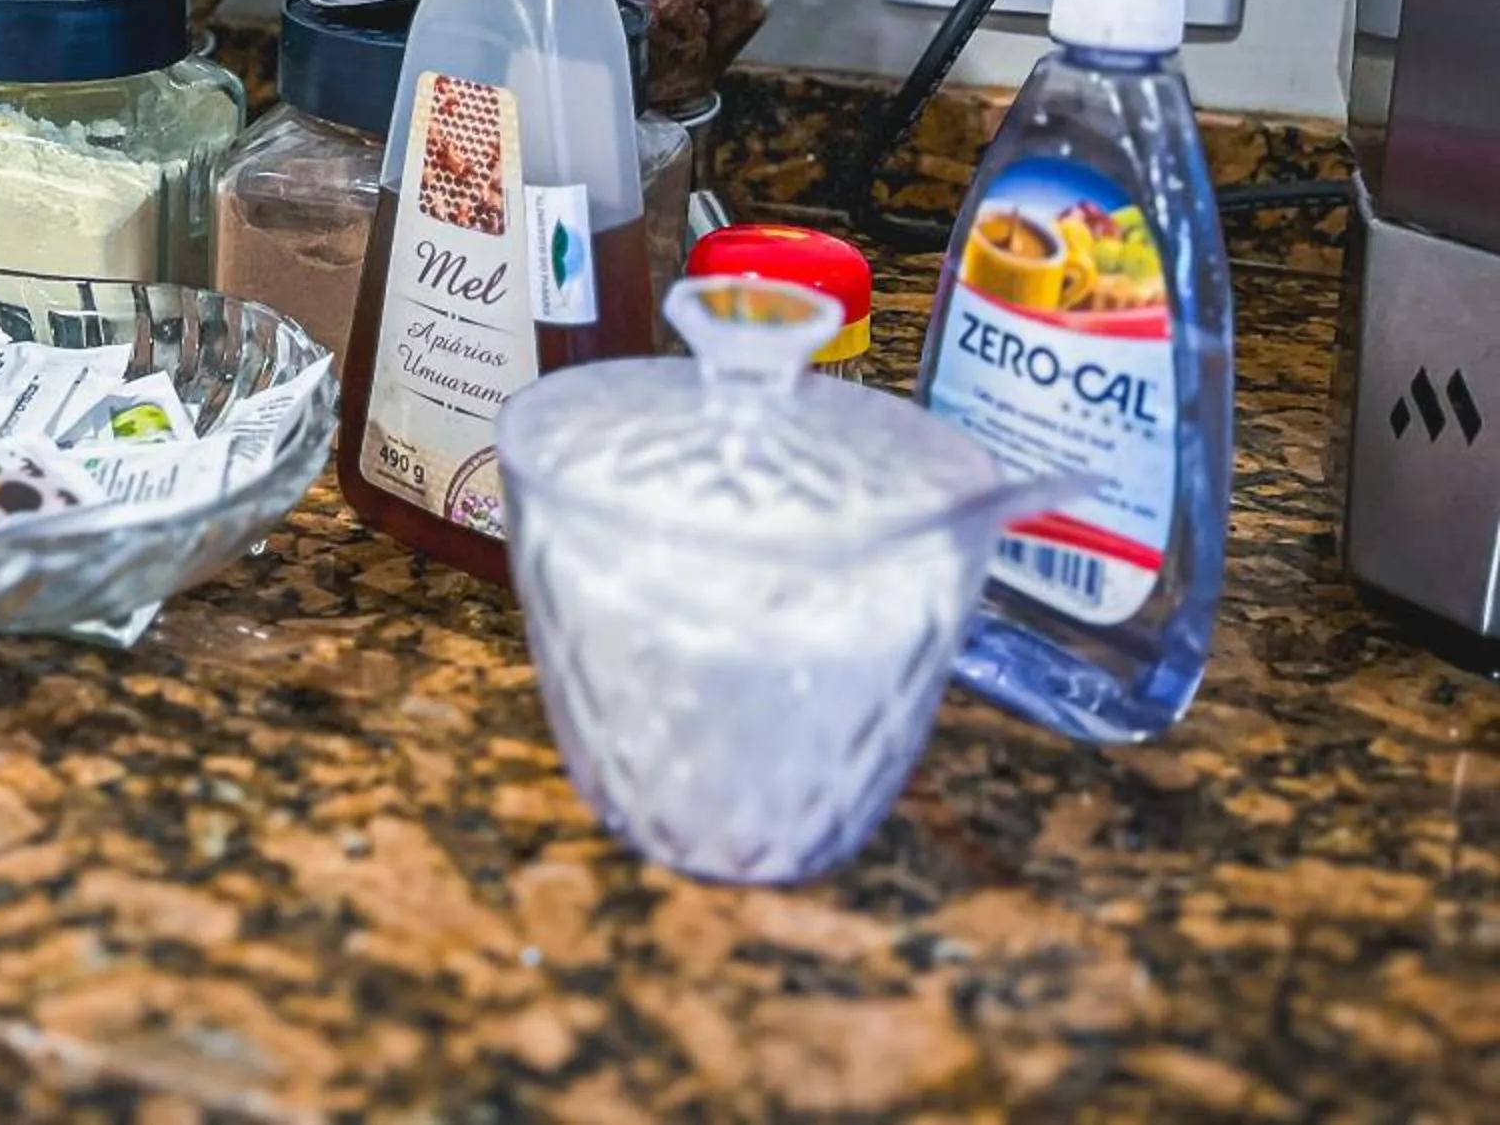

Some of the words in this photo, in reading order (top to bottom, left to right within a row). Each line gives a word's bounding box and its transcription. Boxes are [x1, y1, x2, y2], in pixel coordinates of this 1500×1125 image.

[417, 240, 508, 305] Mel
[407, 321, 508, 368] Apiários
[380, 444, 409, 472] 490
[413, 465, 425, 484] g
